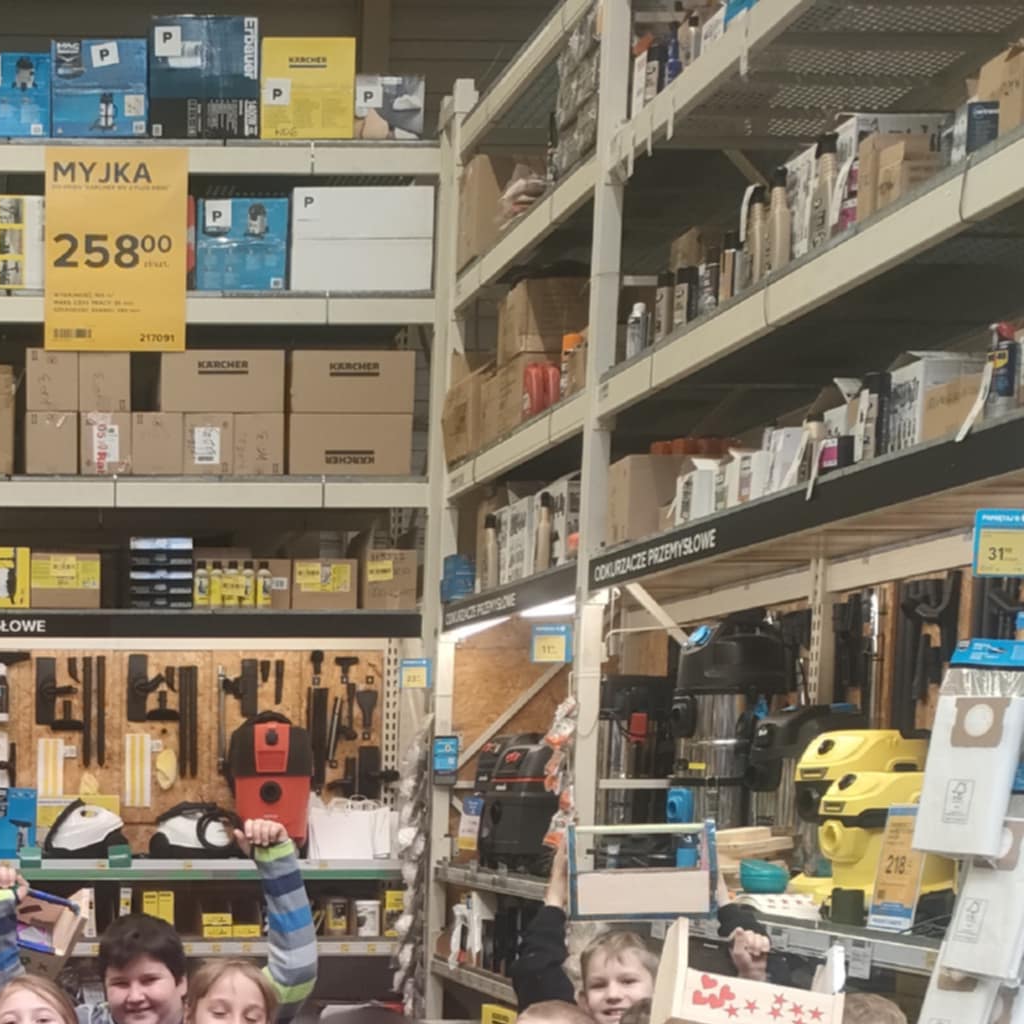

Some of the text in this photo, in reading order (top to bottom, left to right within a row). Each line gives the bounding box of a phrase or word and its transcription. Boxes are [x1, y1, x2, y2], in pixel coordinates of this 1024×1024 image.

[163, 32, 174, 44] P
[100, 50, 111, 61] P
[272, 89, 283, 100] P
[364, 91, 374, 103] P
[52, 161, 152, 183] MYJKA
[304, 197, 315, 208] P
[213, 211, 222, 222] P
[53, 233, 172, 269] 258 00
[140, 333, 175, 343] 217091
[594, 528, 717, 581] ODKURZACZE PRZEMYSŁOWE
[988, 547, 1004, 560] 31
